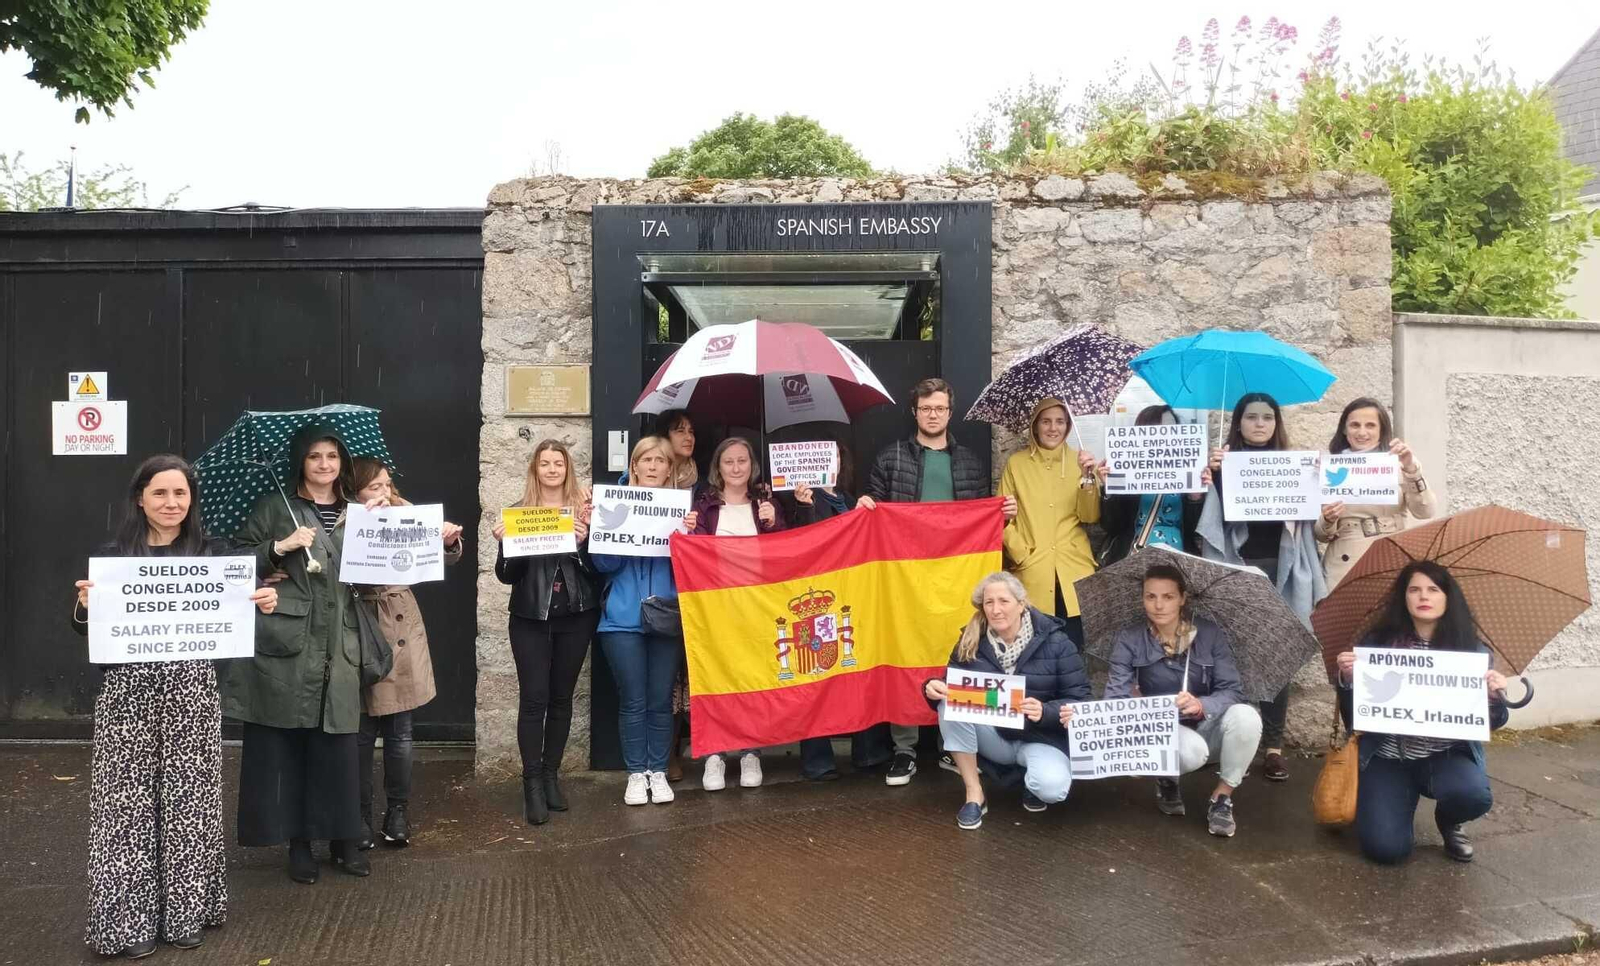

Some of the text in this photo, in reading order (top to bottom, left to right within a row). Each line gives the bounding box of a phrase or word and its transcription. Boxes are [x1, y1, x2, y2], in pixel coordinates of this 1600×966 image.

[640, 220, 670, 237] 17A
[777, 217, 942, 236] SPANISH EMBASSY
[1107, 425, 1203, 437] ABANDONED!
[65, 434, 114, 444] NO PARKING
[1108, 437, 1202, 449] LOCAL EMPLOYEES
[65, 443, 114, 452] DAY OR NIGHT
[772, 442, 833, 452] ABANDONED!
[1110, 447, 1200, 459] OF THE SPANISH
[798, 457, 831, 465] SPANISH
[1114, 458, 1198, 470] GOVERNMENT
[1249, 457, 1292, 465] SUELDOS
[776, 464, 829, 474] GOVERNMENT
[1239, 468, 1301, 477] CONGELADOS
[1351, 466, 1394, 475] FOLLOW US!
[1134, 471, 1177, 480] OFFICES
[1127, 482, 1184, 491] IN IRELAND
[1242, 480, 1300, 489] DESDE 2009
[1321, 488, 1395, 497] @PLEX_Irlanda
[1235, 495, 1307, 504] SALARY FREEZE
[522, 508, 553, 516] SUELDOS
[633, 505, 686, 519] FOLLOW US!
[1244, 507, 1299, 516] SINCE 2009
[516, 516, 560, 525] CONGELADOS
[513, 536, 538, 544] SALARY
[592, 531, 669, 546] @PLEX_Irlan
[138, 565, 209, 577] SUELDOS
[121, 582, 225, 596] CONGELADOS
[125, 600, 220, 613] DESDE 2009
[110, 622, 233, 638] SALARY FREEZE
[126, 640, 217, 655] SINCE 2009
[1368, 651, 1434, 668] APÓYANOS
[961, 676, 1006, 692] PLEX
[1408, 673, 1483, 690] FOLLOW US!
[952, 698, 1018, 718] Irlanda
[1072, 697, 1174, 715] ABANDONED
[1071, 710, 1175, 728] LOCAL EMPLOYEES
[1357, 704, 1485, 726] @PLEX_Irlanda
[1074, 721, 1174, 740] OF THE SPANISH
[1079, 734, 1171, 752] GOVERNMENT
[1102, 749, 1150, 761] OFFICES
[1096, 761, 1159, 775] IN IRELAND
